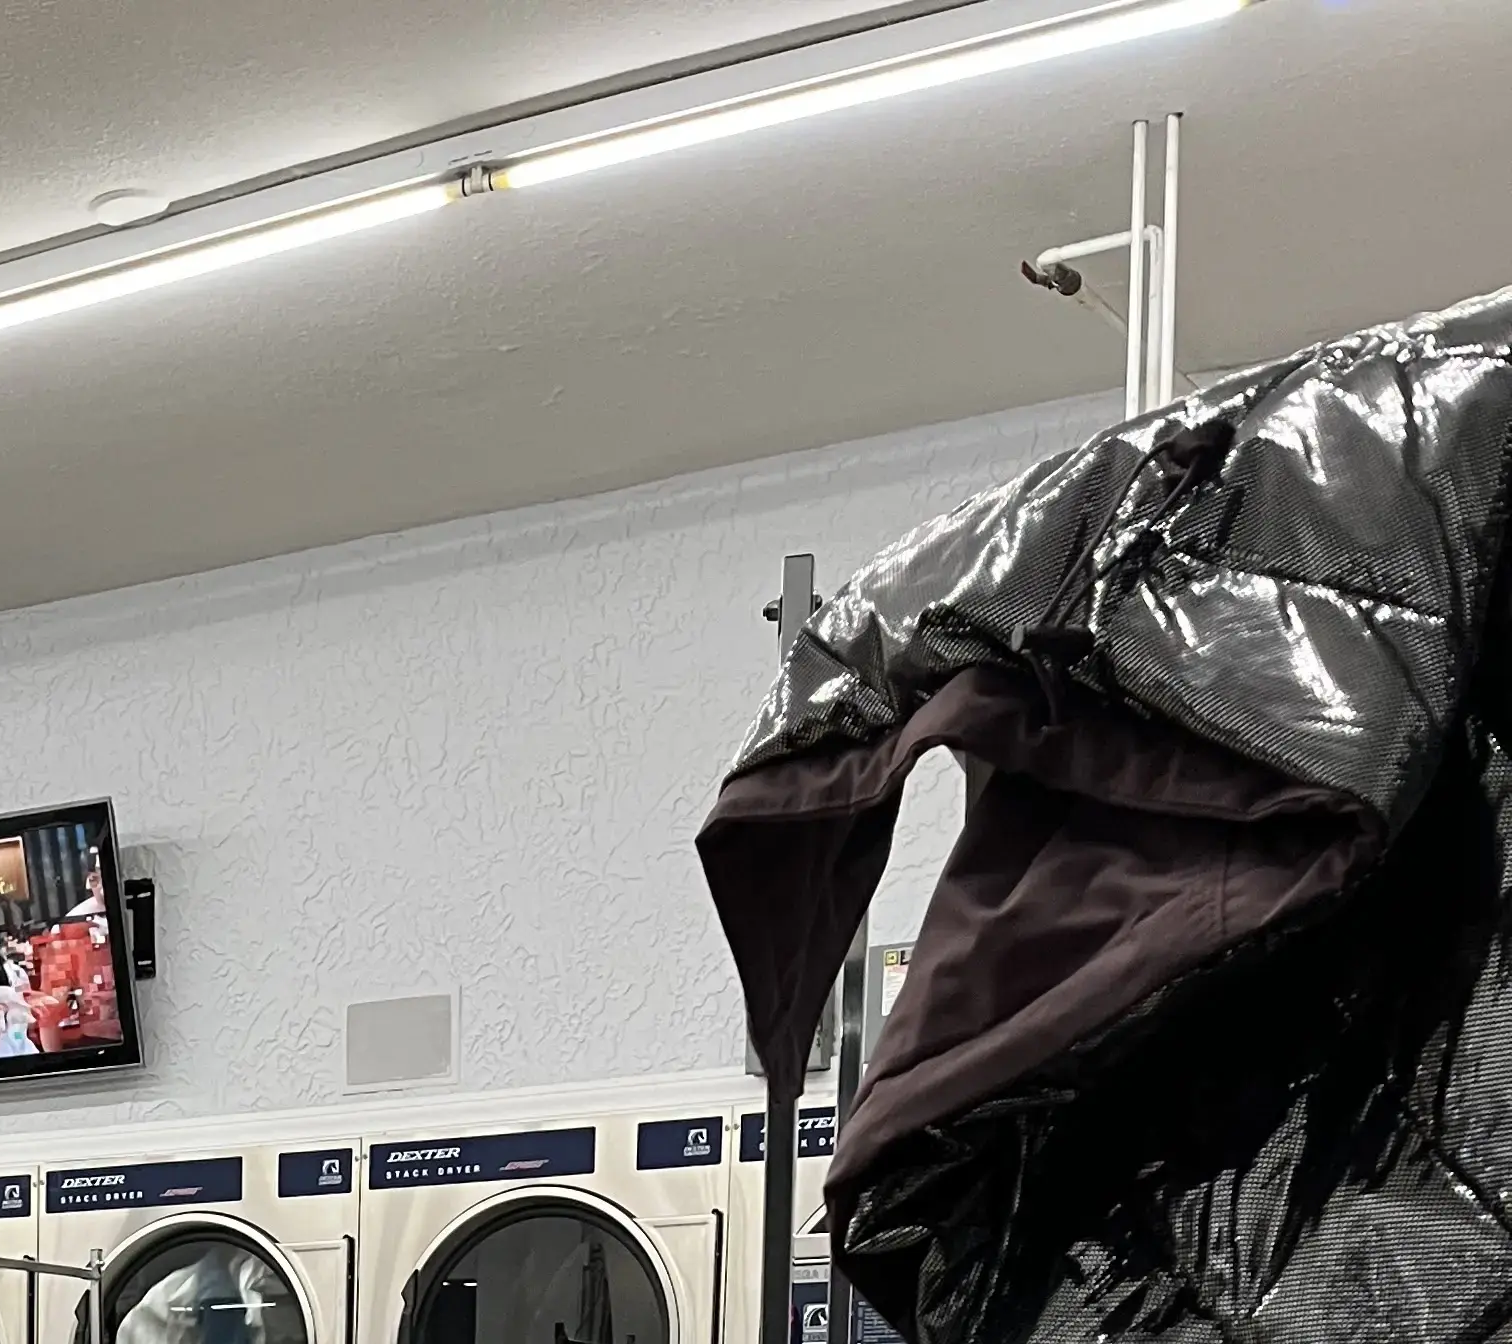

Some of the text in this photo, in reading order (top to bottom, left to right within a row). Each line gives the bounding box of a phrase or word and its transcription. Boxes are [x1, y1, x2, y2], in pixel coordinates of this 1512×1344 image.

[387, 1146, 461, 1163] DEXTER
[385, 1164, 481, 1180] STACK DRYER
[61, 1174, 126, 1189] DEXTER
[60, 1190, 143, 1204] STACK DRYER
